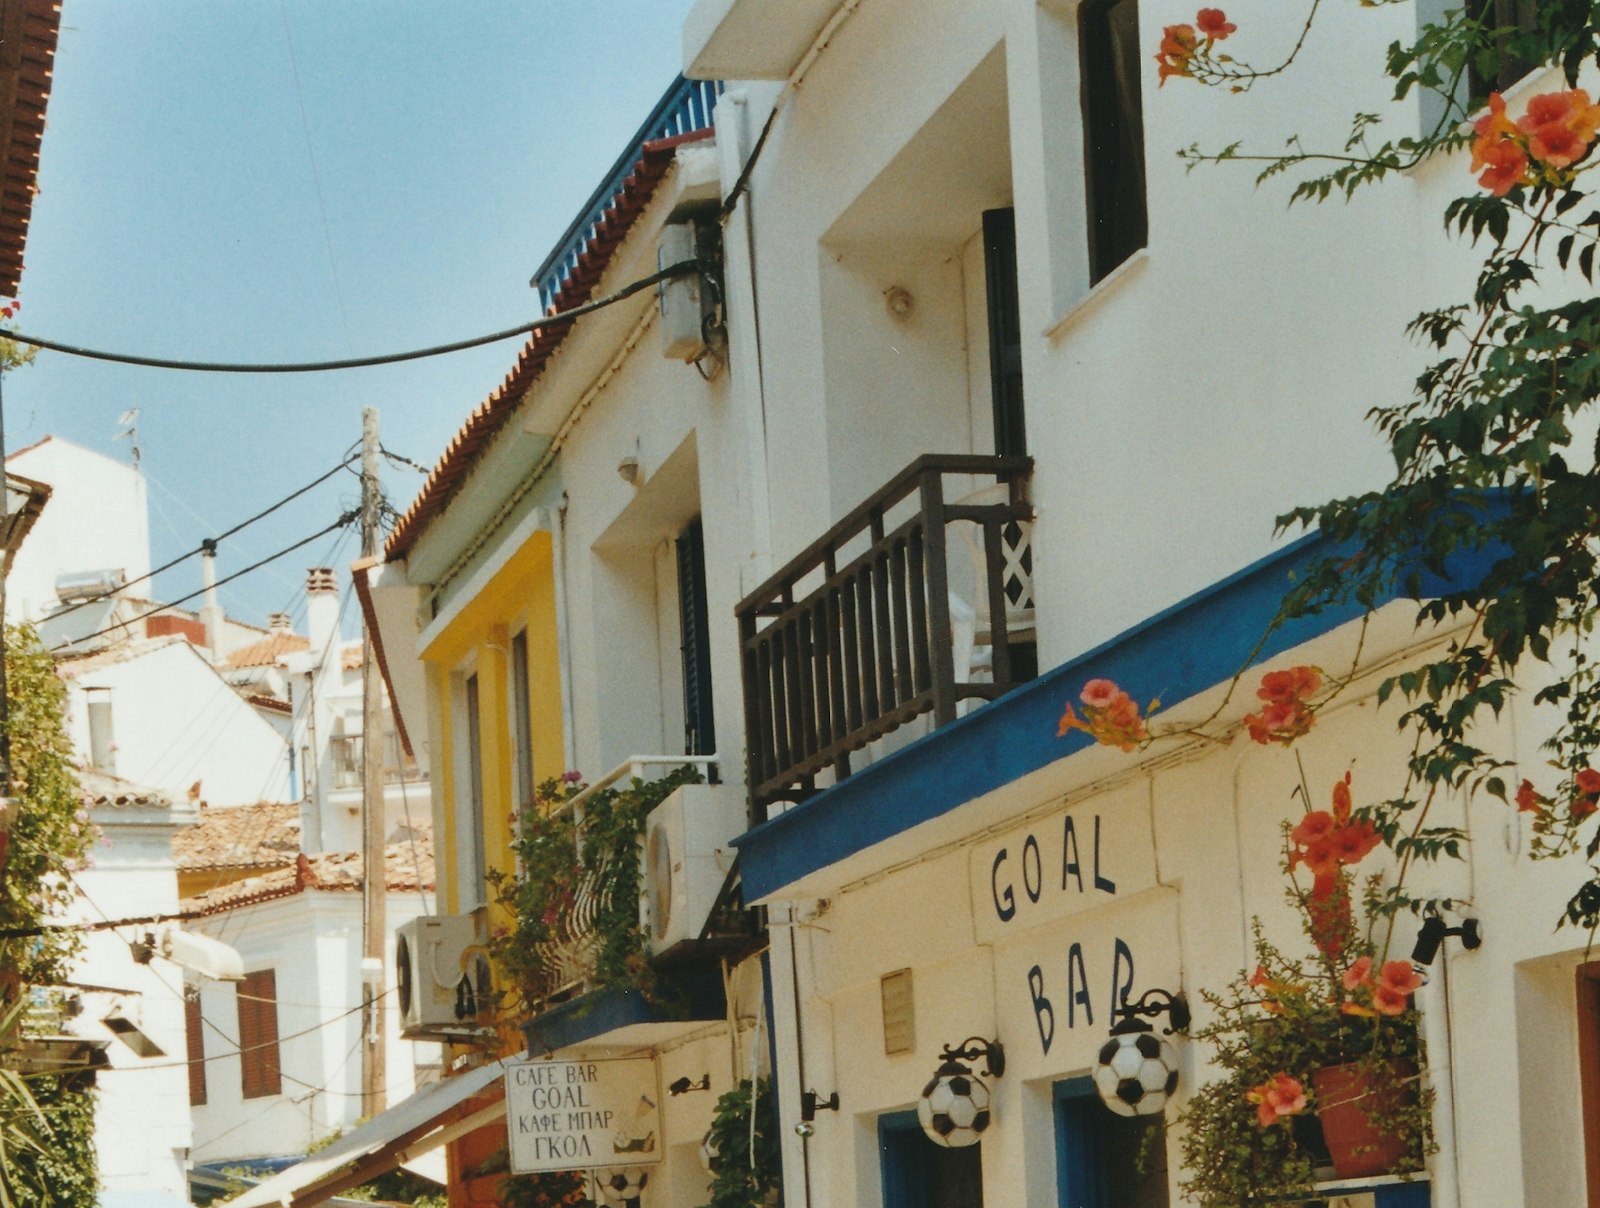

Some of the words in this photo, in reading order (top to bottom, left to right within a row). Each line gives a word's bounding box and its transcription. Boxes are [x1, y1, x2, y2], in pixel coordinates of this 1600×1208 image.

[992, 814, 1116, 922] GOAL
[1028, 937, 1134, 1057] BAR
[516, 1066, 557, 1087] CAFE
[566, 1064, 598, 1084] BAR
[532, 1085, 591, 1110] GOAL
[518, 1113, 562, 1134] ΚΑΦΕ
[568, 1110, 614, 1131] ΜΠΑΡ
[534, 1134, 592, 1160] ΓΚΟΛ
